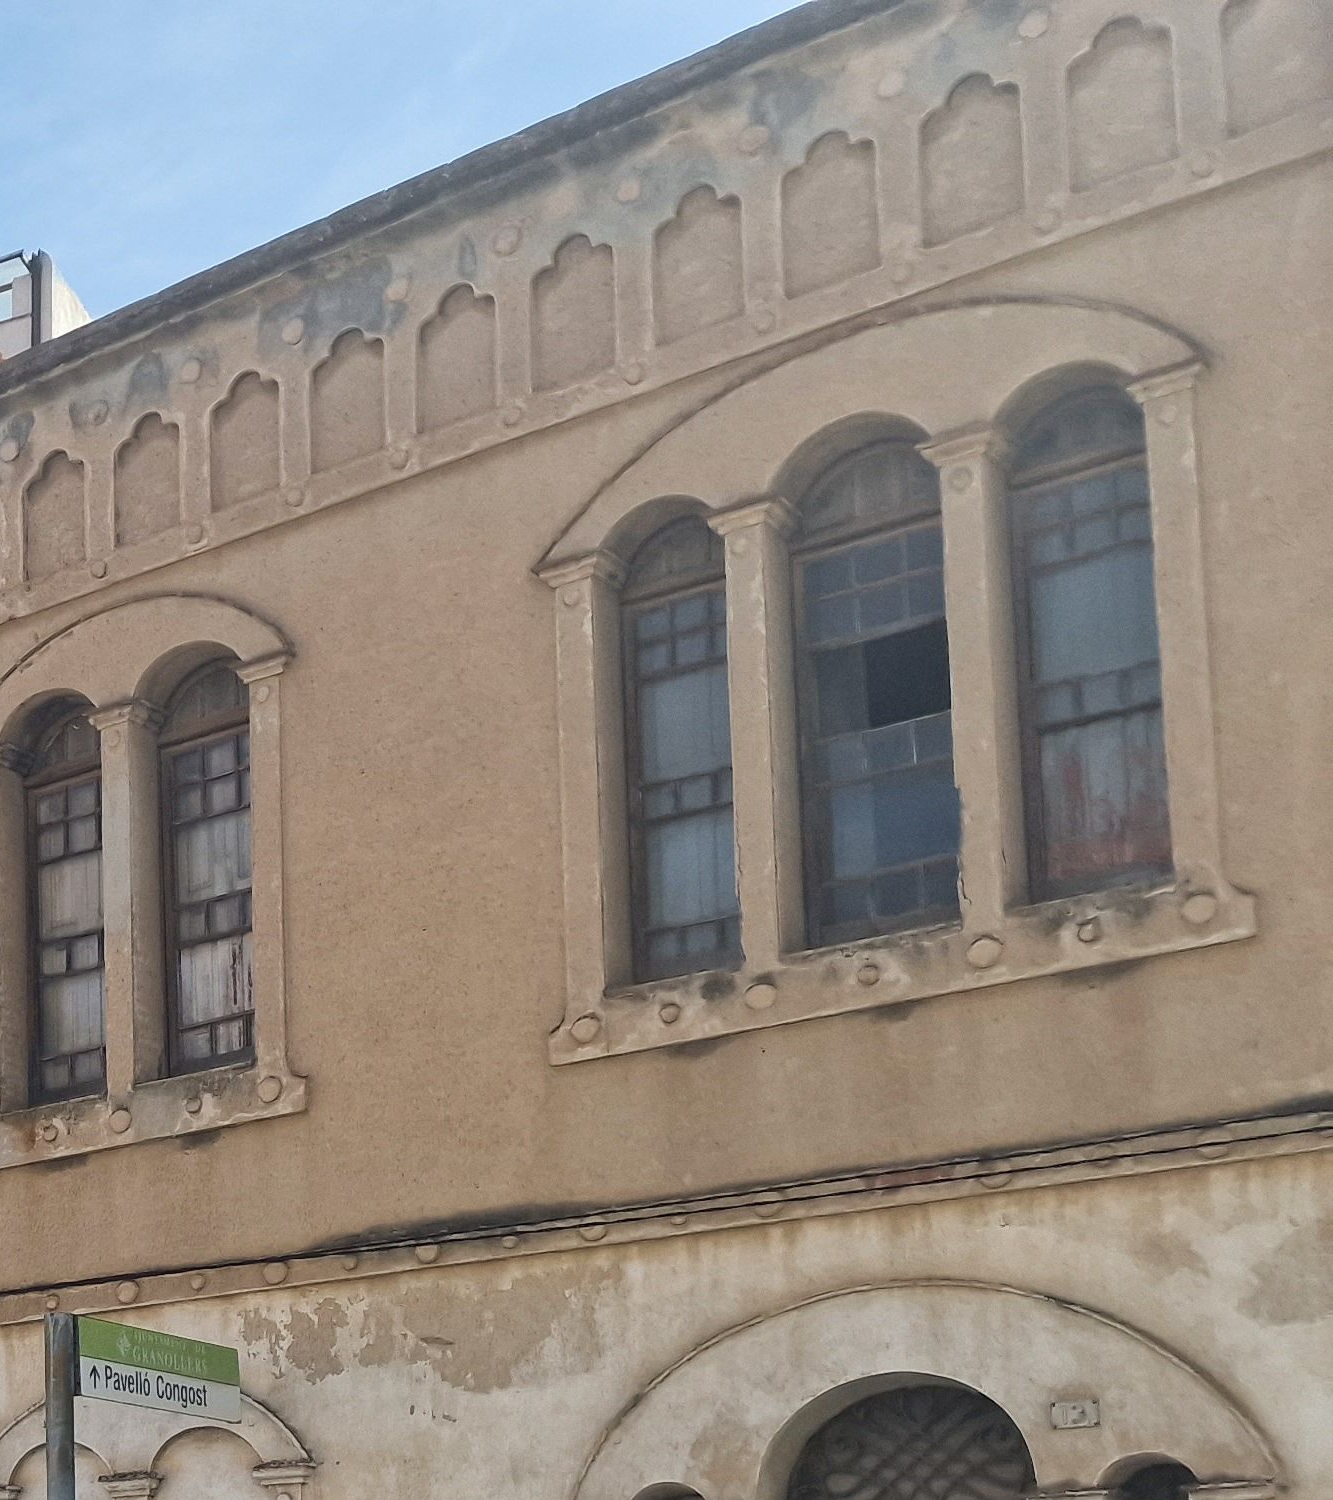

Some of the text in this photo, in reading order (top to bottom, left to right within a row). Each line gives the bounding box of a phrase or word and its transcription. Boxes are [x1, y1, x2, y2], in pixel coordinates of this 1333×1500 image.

[132, 1346, 207, 1375] GRANOLLERS
[104, 1364, 208, 1408] Pavelló Congost
